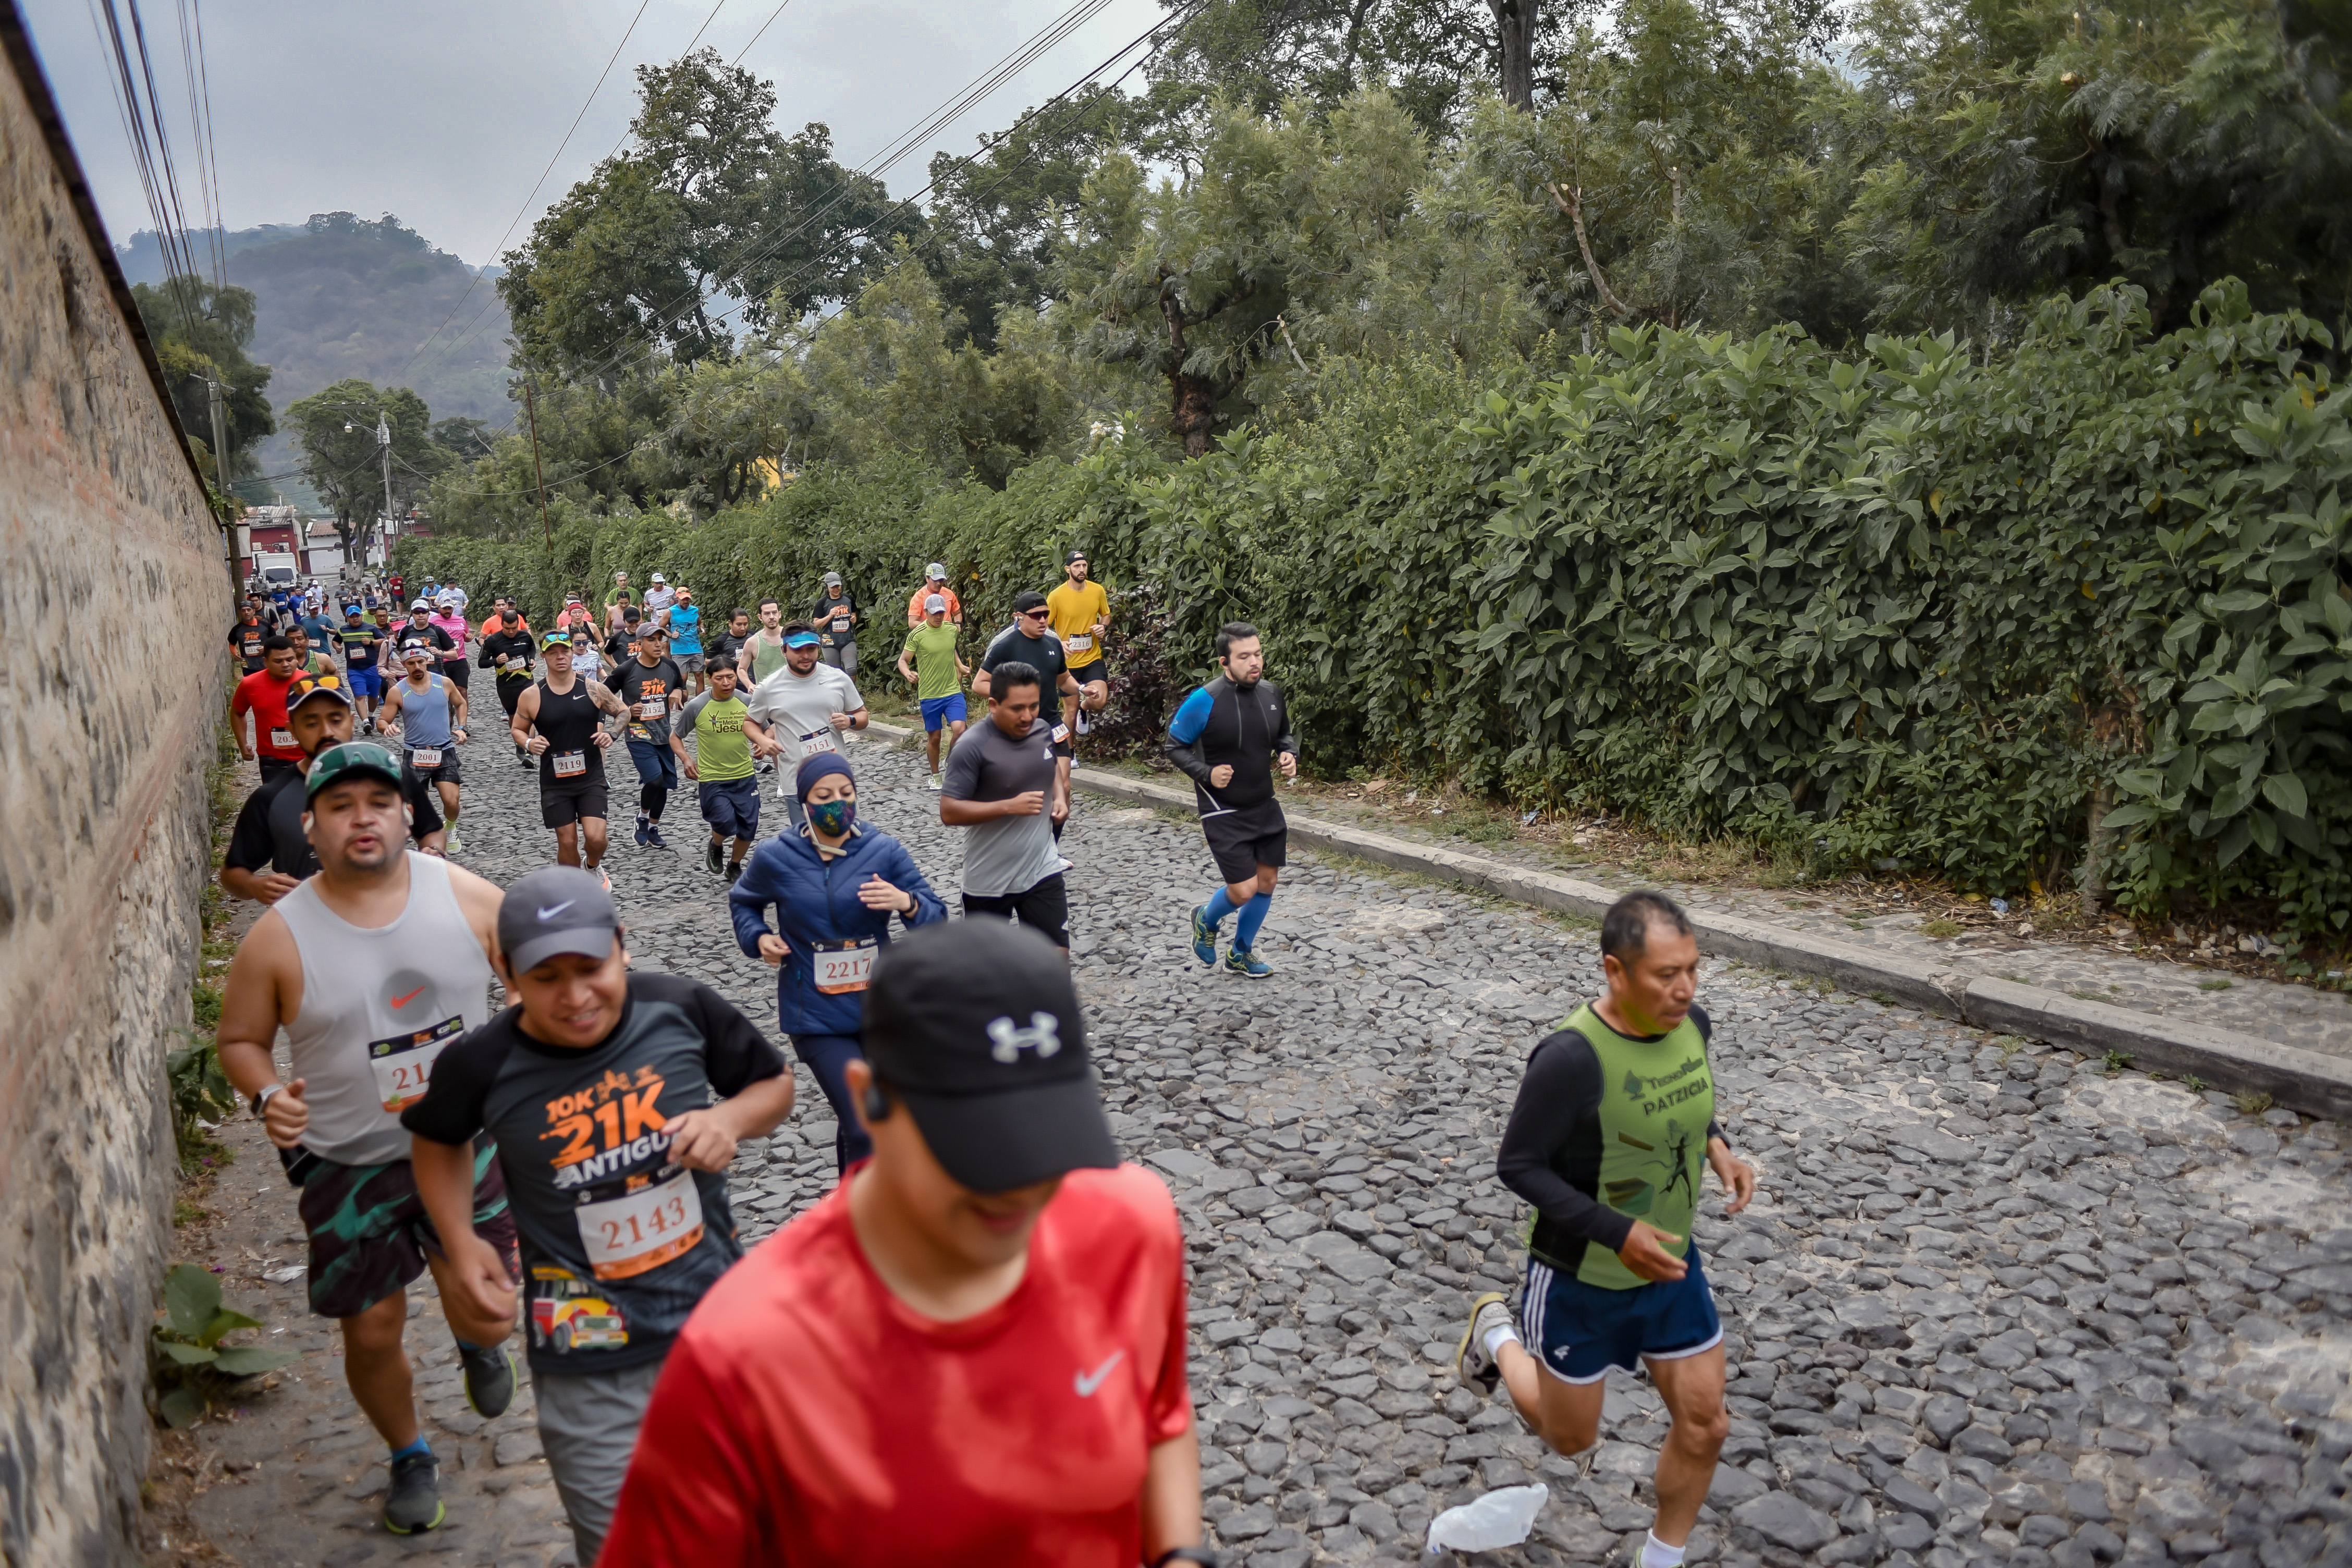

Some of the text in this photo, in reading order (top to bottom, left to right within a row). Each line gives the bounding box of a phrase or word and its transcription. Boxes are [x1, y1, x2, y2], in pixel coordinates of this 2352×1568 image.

[640, 683, 666, 696] 21K
[643, 706, 662, 714] 2152
[277, 735, 298, 743] 203
[806, 739, 830, 754] 2151
[558, 760, 581, 770] 2119
[826, 957, 871, 979] 2217
[392, 1059, 437, 1090] 21
[545, 1086, 595, 1124] 10K
[1643, 1077, 1709, 1116] PATZICIA
[543, 1081, 668, 1168] 21K
[553, 1132, 679, 1189] ANTIGU
[601, 1196, 687, 1250] 2143
